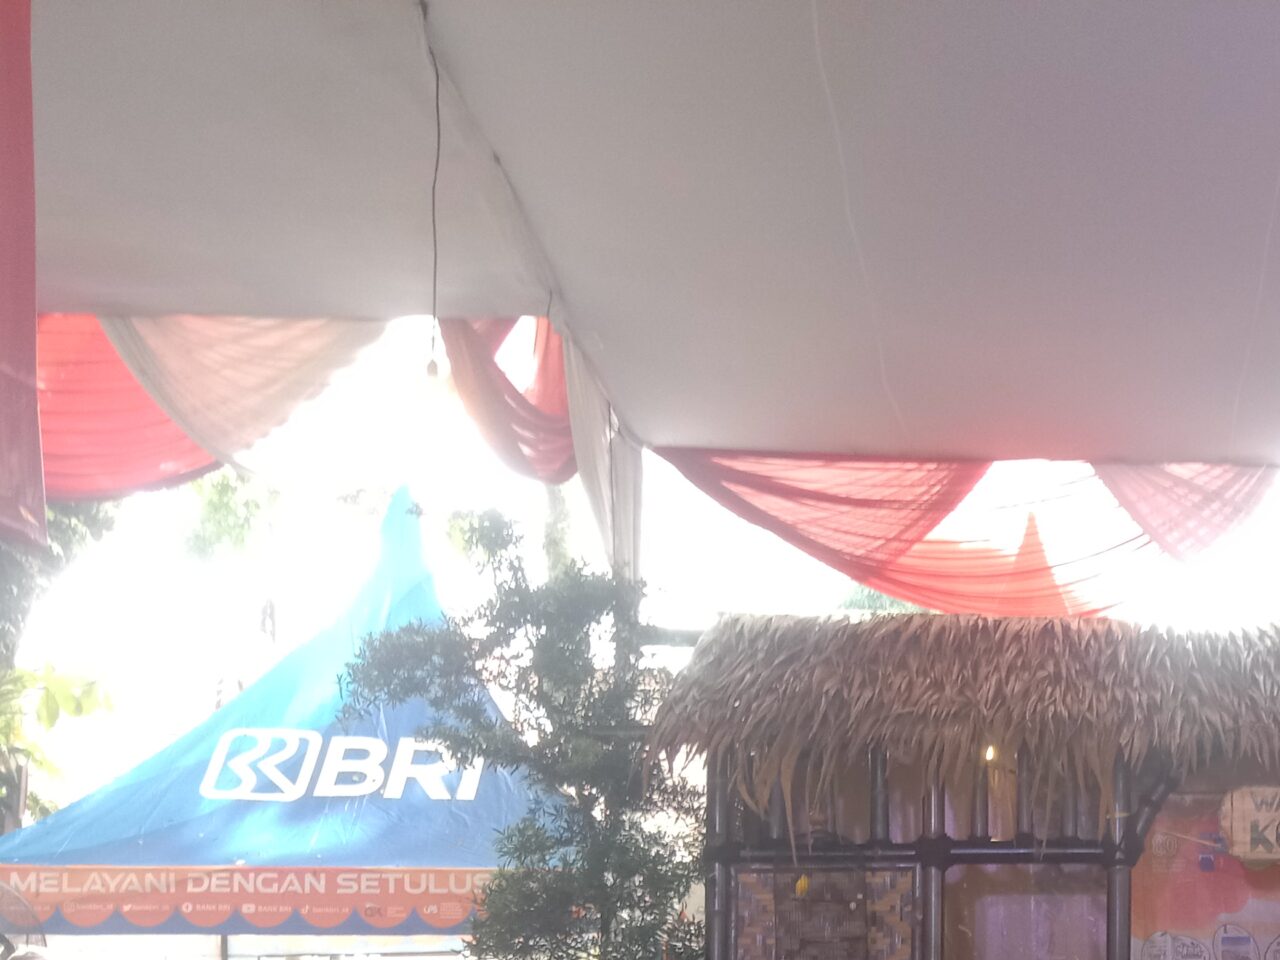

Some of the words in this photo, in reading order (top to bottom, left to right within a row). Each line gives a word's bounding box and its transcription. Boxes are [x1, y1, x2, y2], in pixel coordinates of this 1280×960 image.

[313, 735, 484, 800] BRI
[9, 872, 176, 893] MELAYANI
[186, 872, 326, 893] DENGAN
